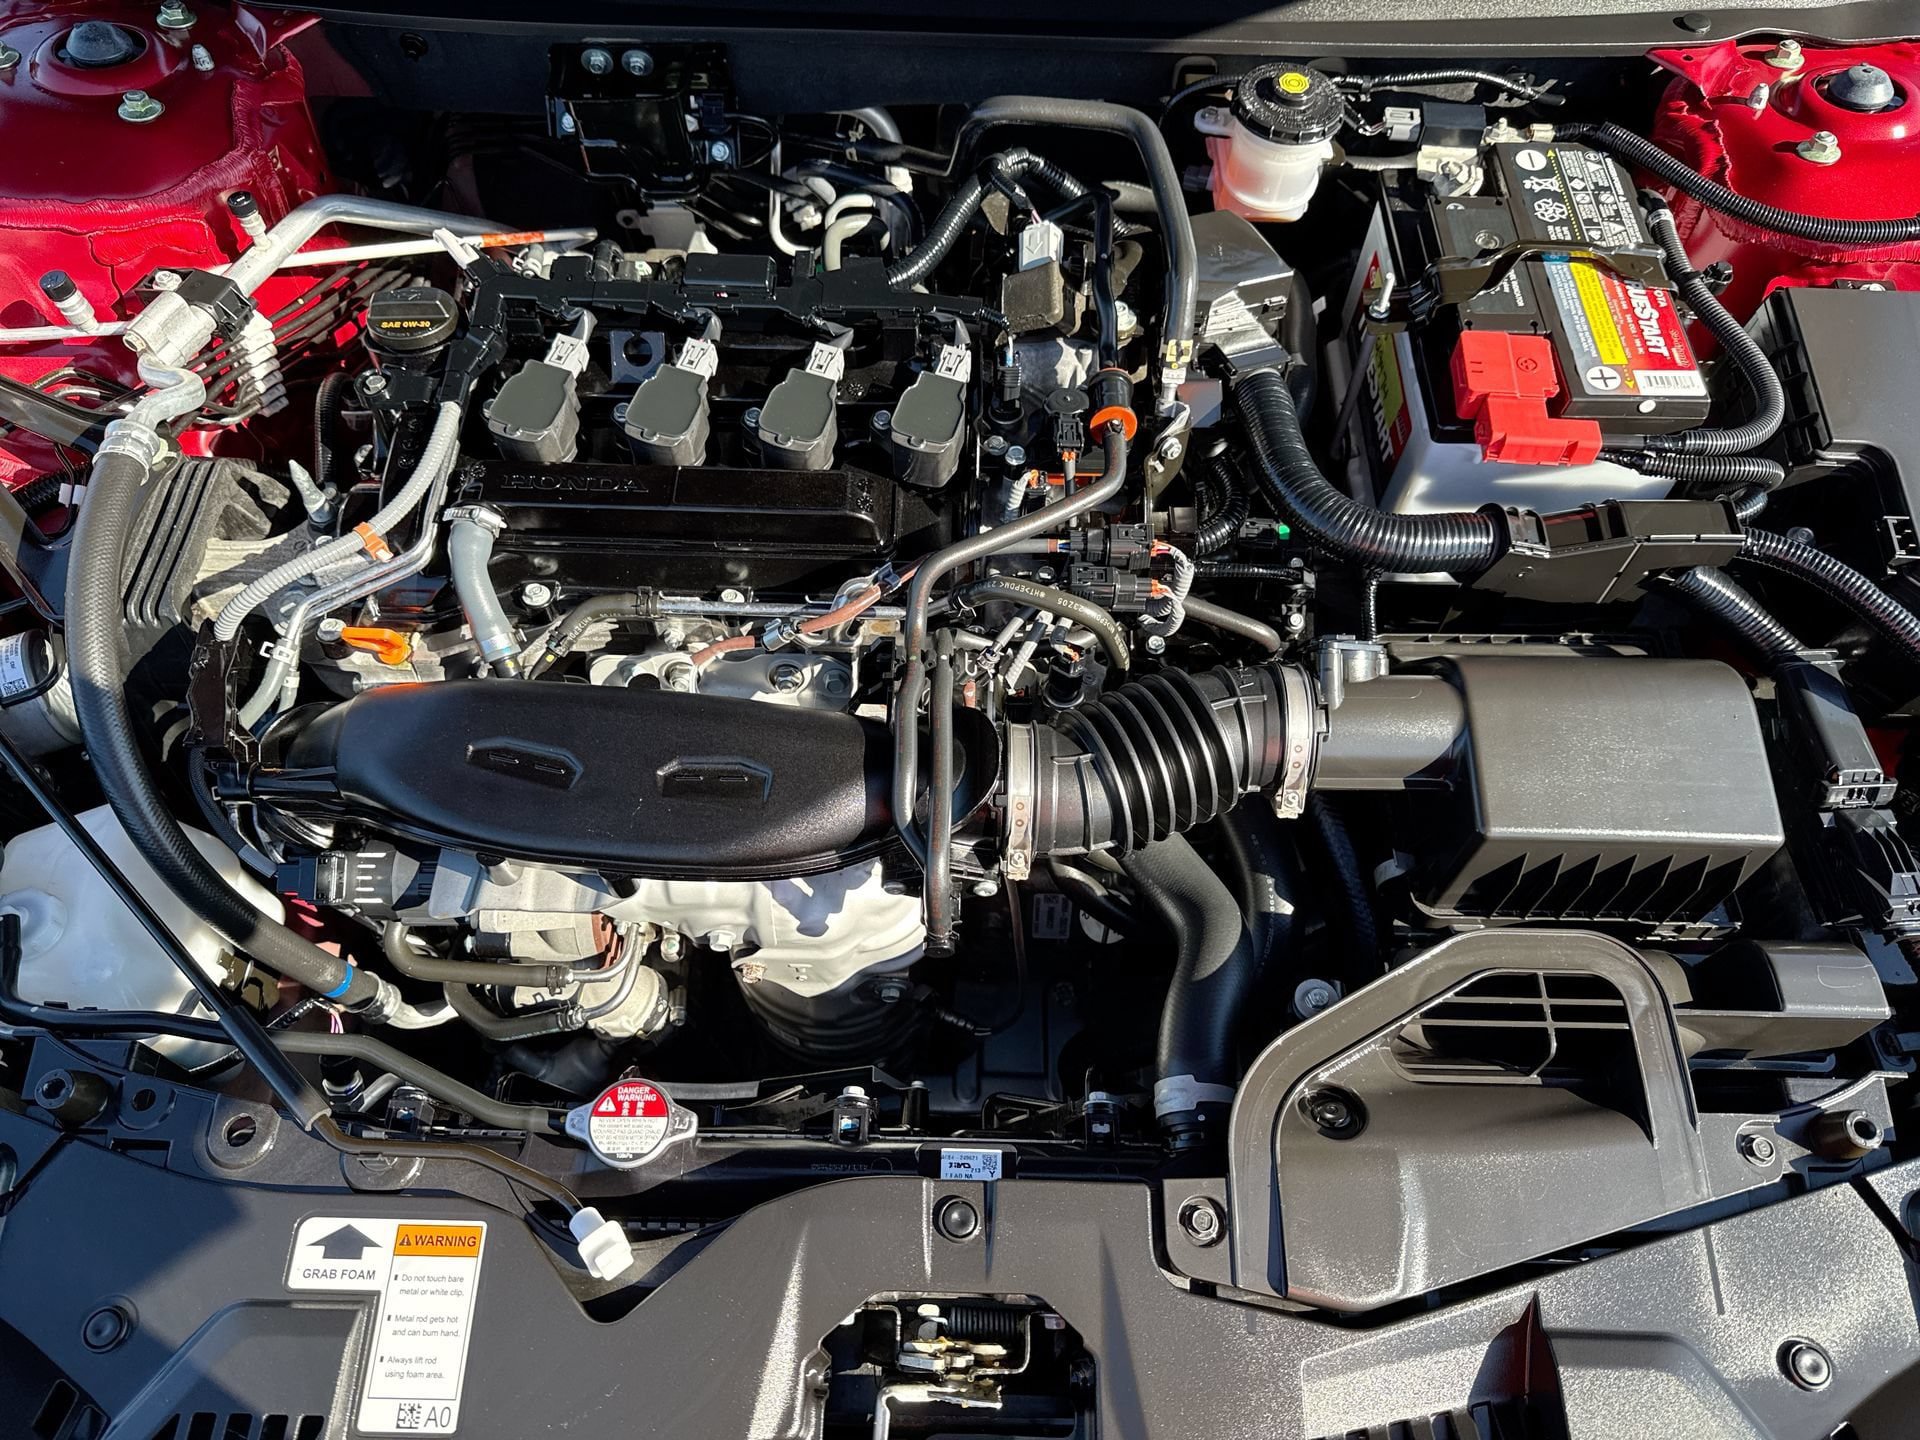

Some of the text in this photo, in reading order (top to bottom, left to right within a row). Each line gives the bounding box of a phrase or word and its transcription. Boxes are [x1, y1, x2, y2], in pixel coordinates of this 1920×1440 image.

[1624, 279, 1670, 358] RUESTART
[381, 321, 401, 329] SAE
[500, 474, 649, 493] HONDA
[414, 1235, 477, 1247] WARNING
[302, 1268, 376, 1280] GRAB FOAM
[401, 1274, 464, 1283] Do not touch bare
[399, 1287, 419, 1296] metal
[429, 1288, 448, 1296] white
[449, 1289, 464, 1298] clip.
[416, 1315, 428, 1323] rod
[429, 1316, 445, 1324] gets
[387, 1356, 413, 1365] Always
[414, 1356, 423, 1364] lift
[384, 1371, 405, 1379] using
[424, 1406, 452, 1428] A0
